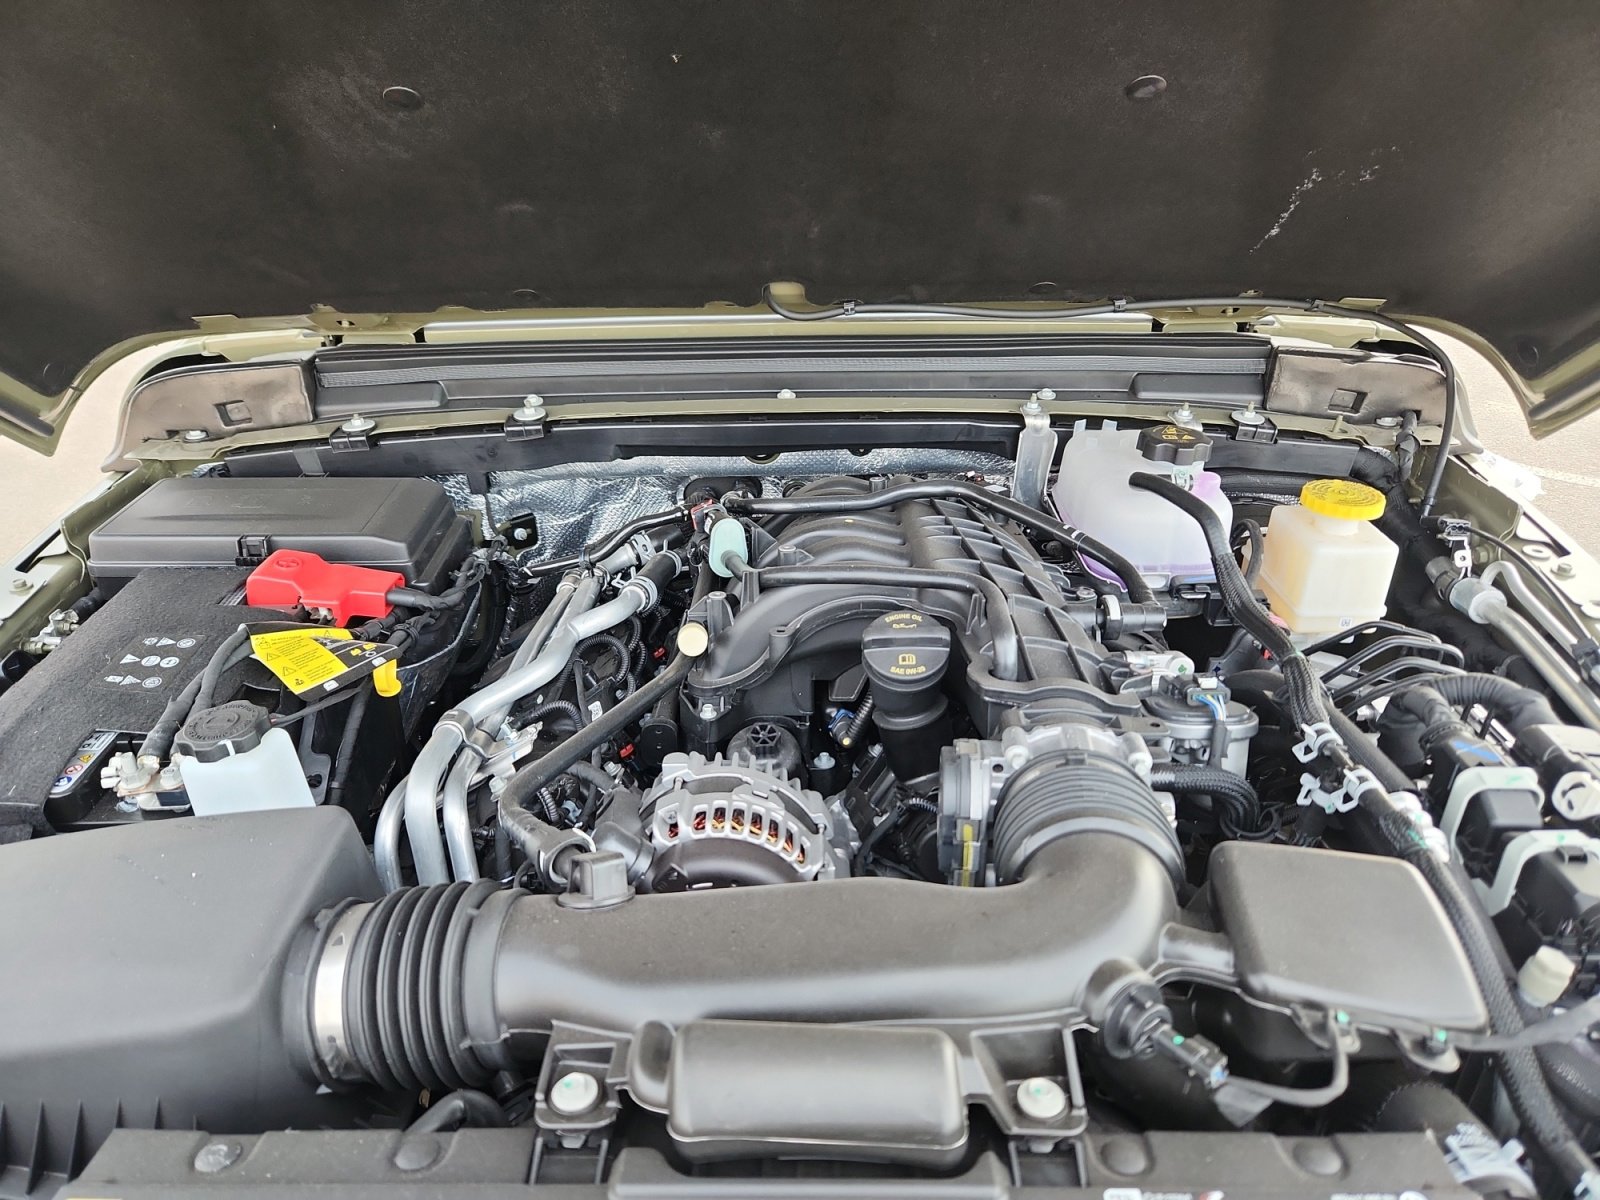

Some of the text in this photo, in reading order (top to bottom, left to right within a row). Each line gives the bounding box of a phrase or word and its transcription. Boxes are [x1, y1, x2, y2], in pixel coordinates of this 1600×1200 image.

[885, 613, 923, 623] ENGINE OIL
[890, 666, 905, 675] SAE
